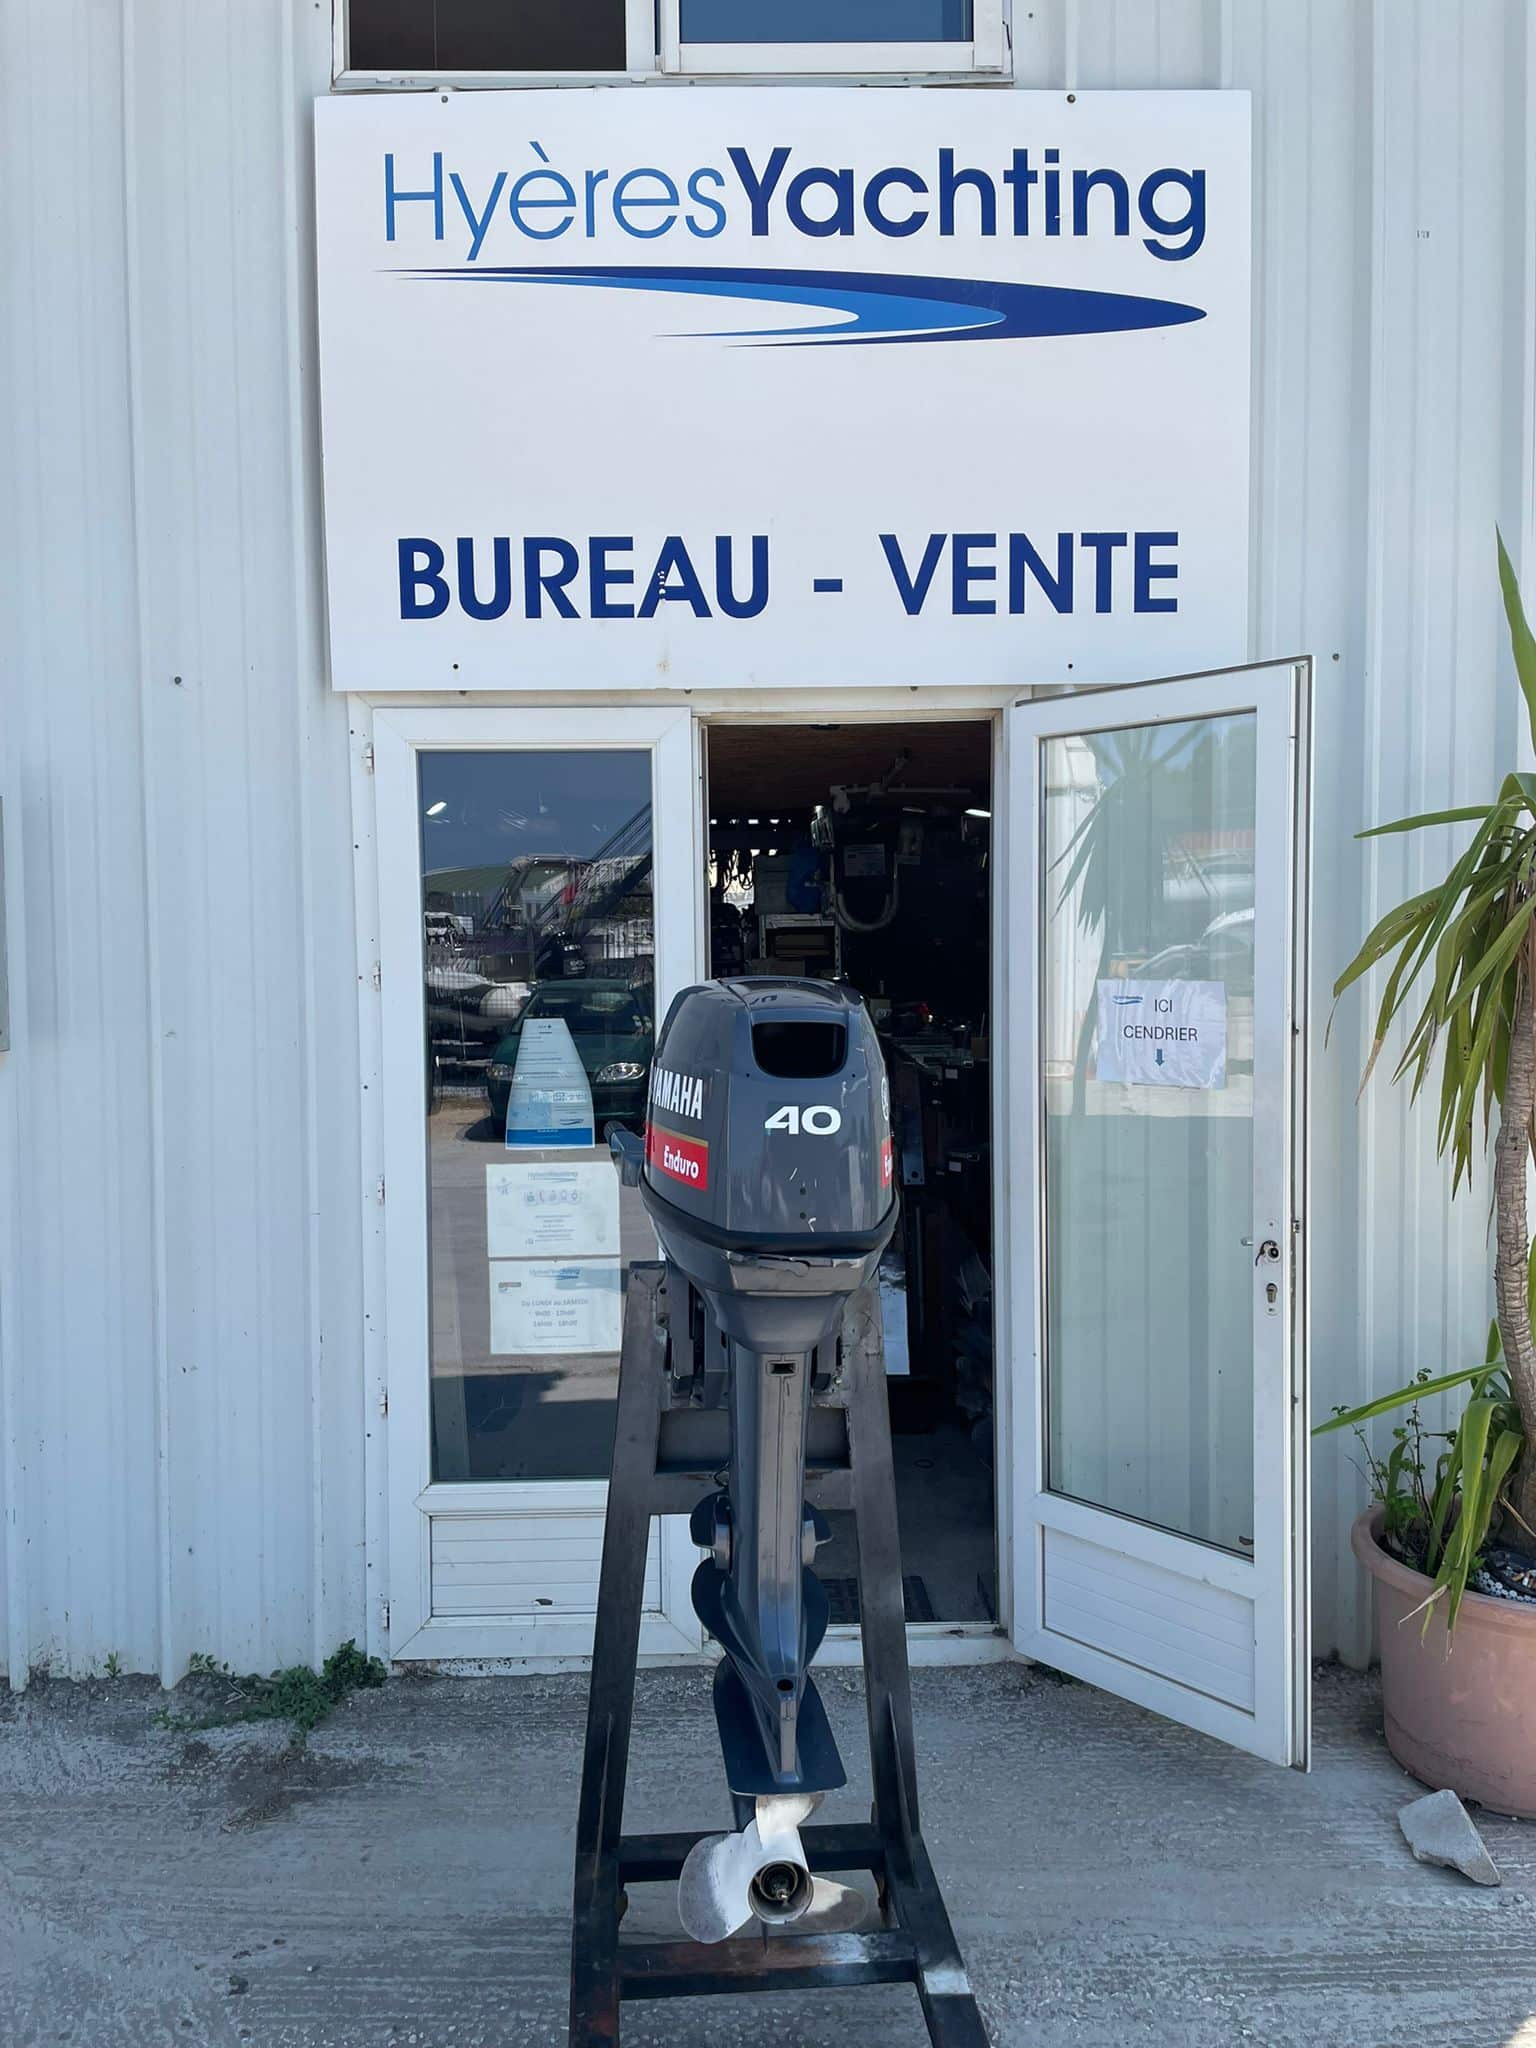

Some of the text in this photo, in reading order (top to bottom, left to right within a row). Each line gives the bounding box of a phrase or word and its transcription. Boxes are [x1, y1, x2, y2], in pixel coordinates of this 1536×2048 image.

[397, 536, 769, 620] BUREAU
[880, 532, 1179, 616] VENTE
[1154, 999, 1173, 1013] ICI
[1123, 1025, 1198, 1041] CENDRIER
[652, 1066, 703, 1120] YAMAHA
[764, 1105, 842, 1135] 40
[663, 1144, 699, 1179] Enduro
